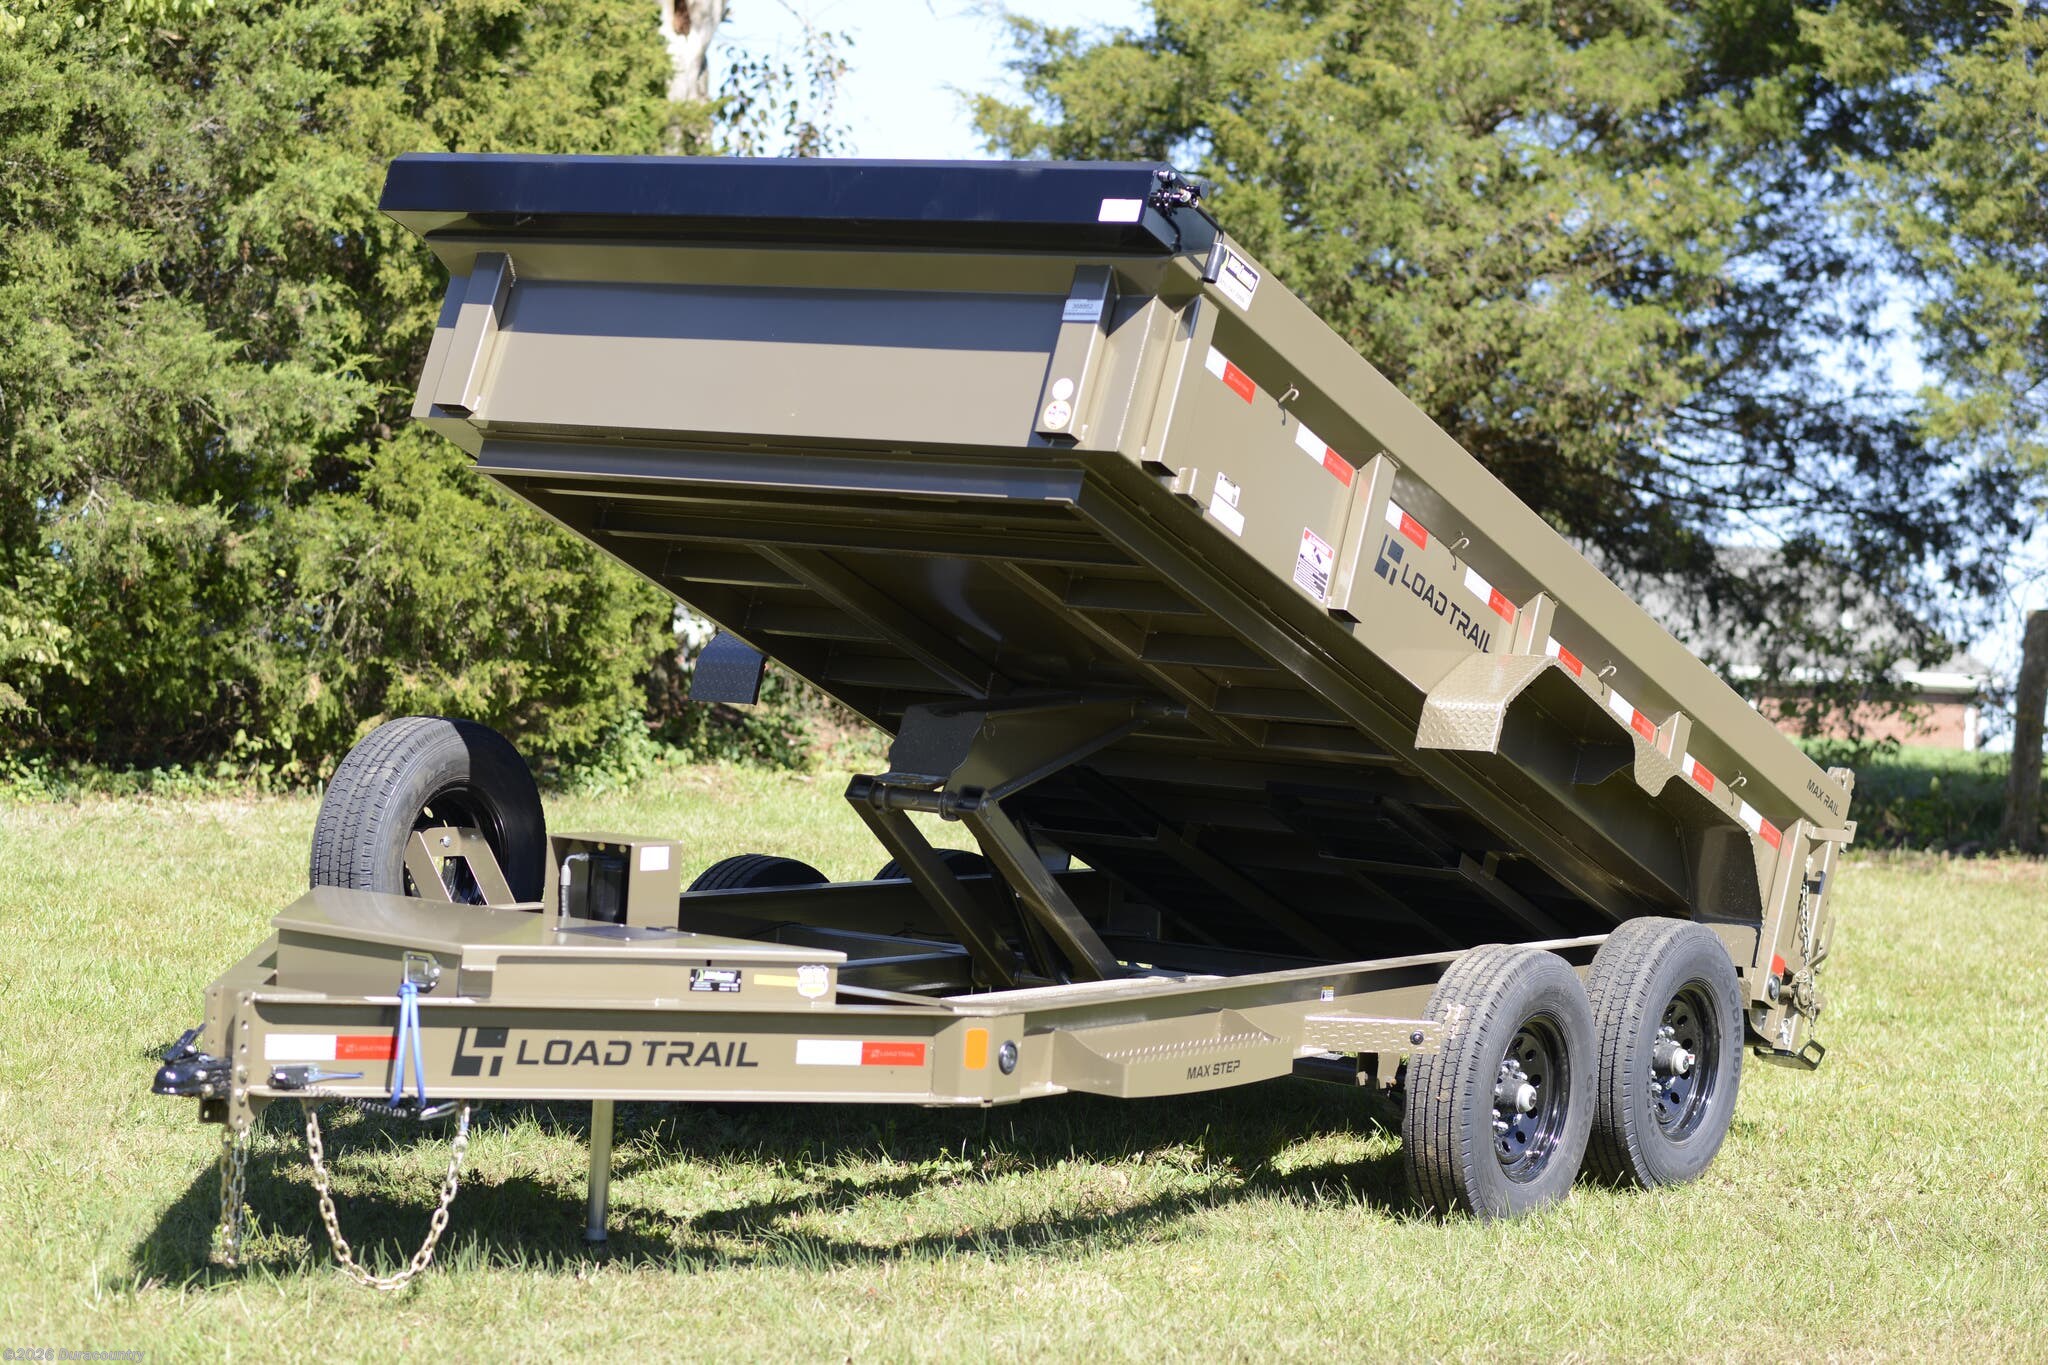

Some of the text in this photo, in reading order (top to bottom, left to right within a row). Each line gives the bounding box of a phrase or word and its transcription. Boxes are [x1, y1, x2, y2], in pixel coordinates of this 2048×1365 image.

[1401, 563, 1490, 653] LOAD TRAIL
[1806, 779, 1838, 817] MAX RAIL
[516, 1039, 760, 1068] LOAD TRAIL
[1187, 1059, 1241, 1080] MAX STEP
